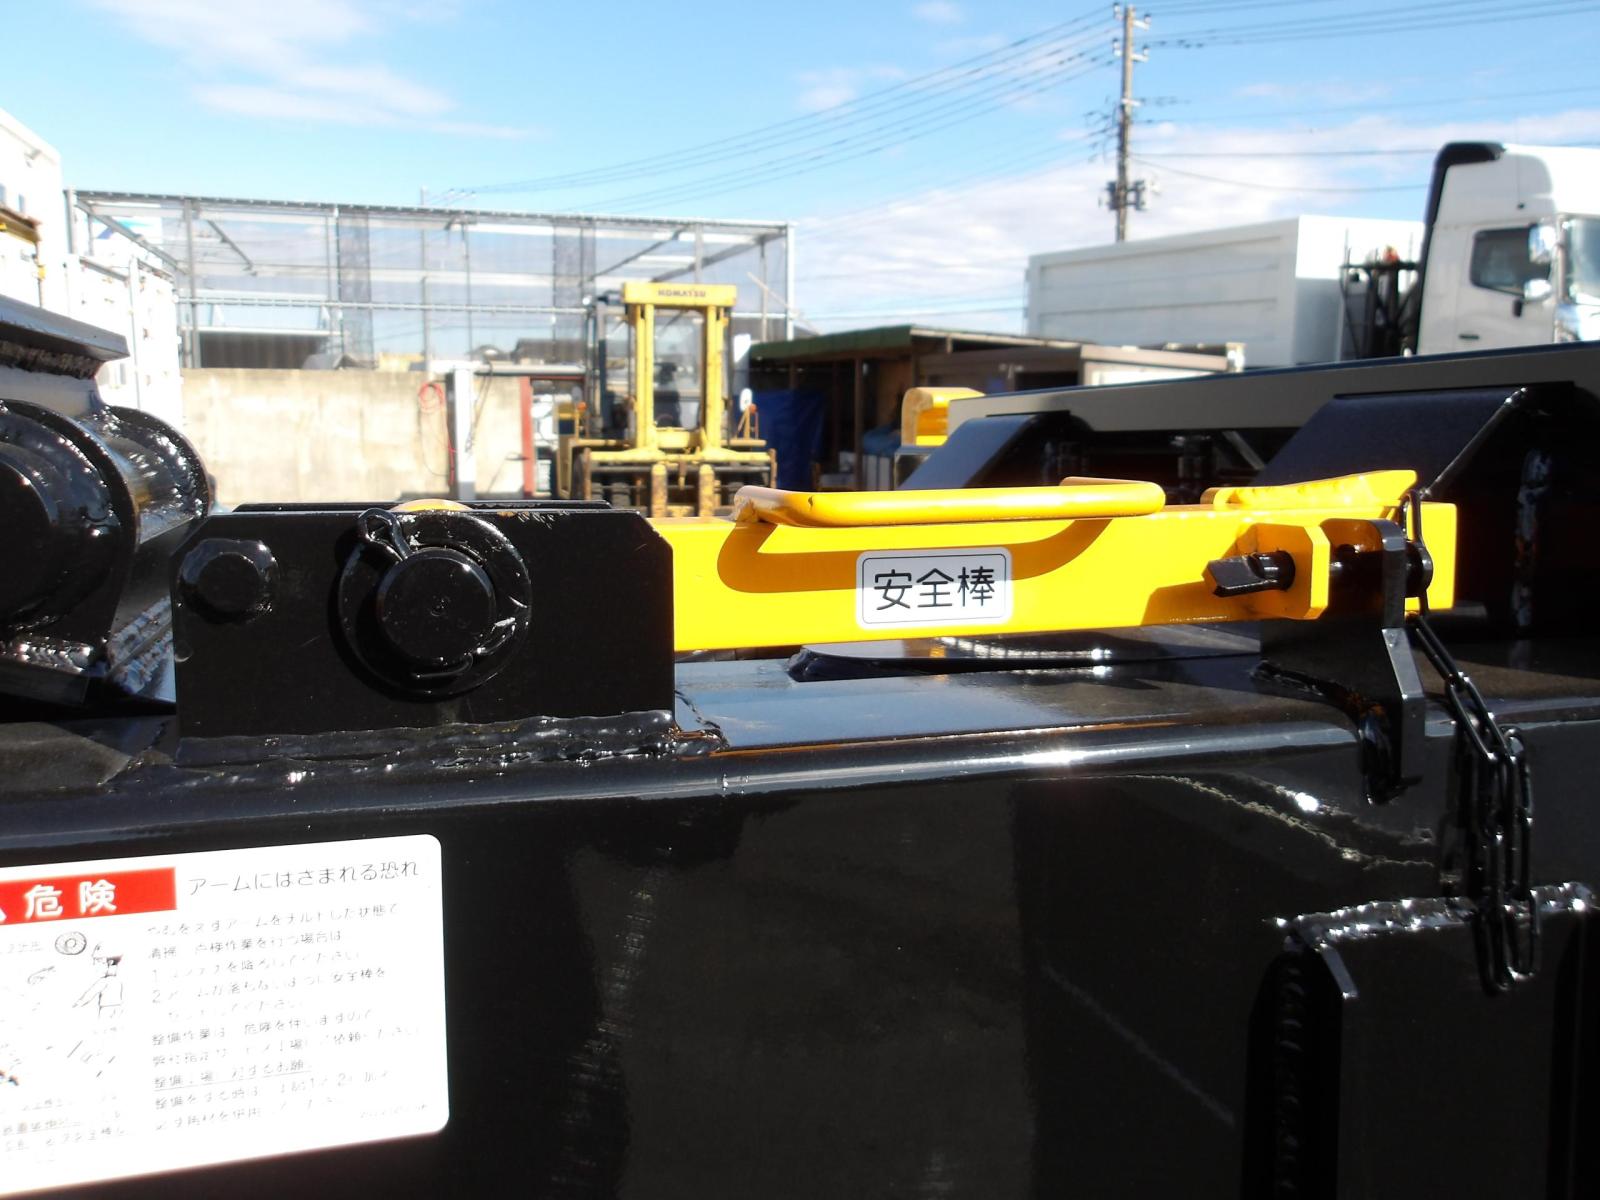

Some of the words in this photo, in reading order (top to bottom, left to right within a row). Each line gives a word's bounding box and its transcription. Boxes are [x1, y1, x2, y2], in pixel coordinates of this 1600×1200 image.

[657, 289, 706, 298] KOMATSU
[873, 565, 996, 611] 安全棒
[188, 860, 419, 896] アームにはさまれる恐れ
[24, 879, 117, 920] 危険
